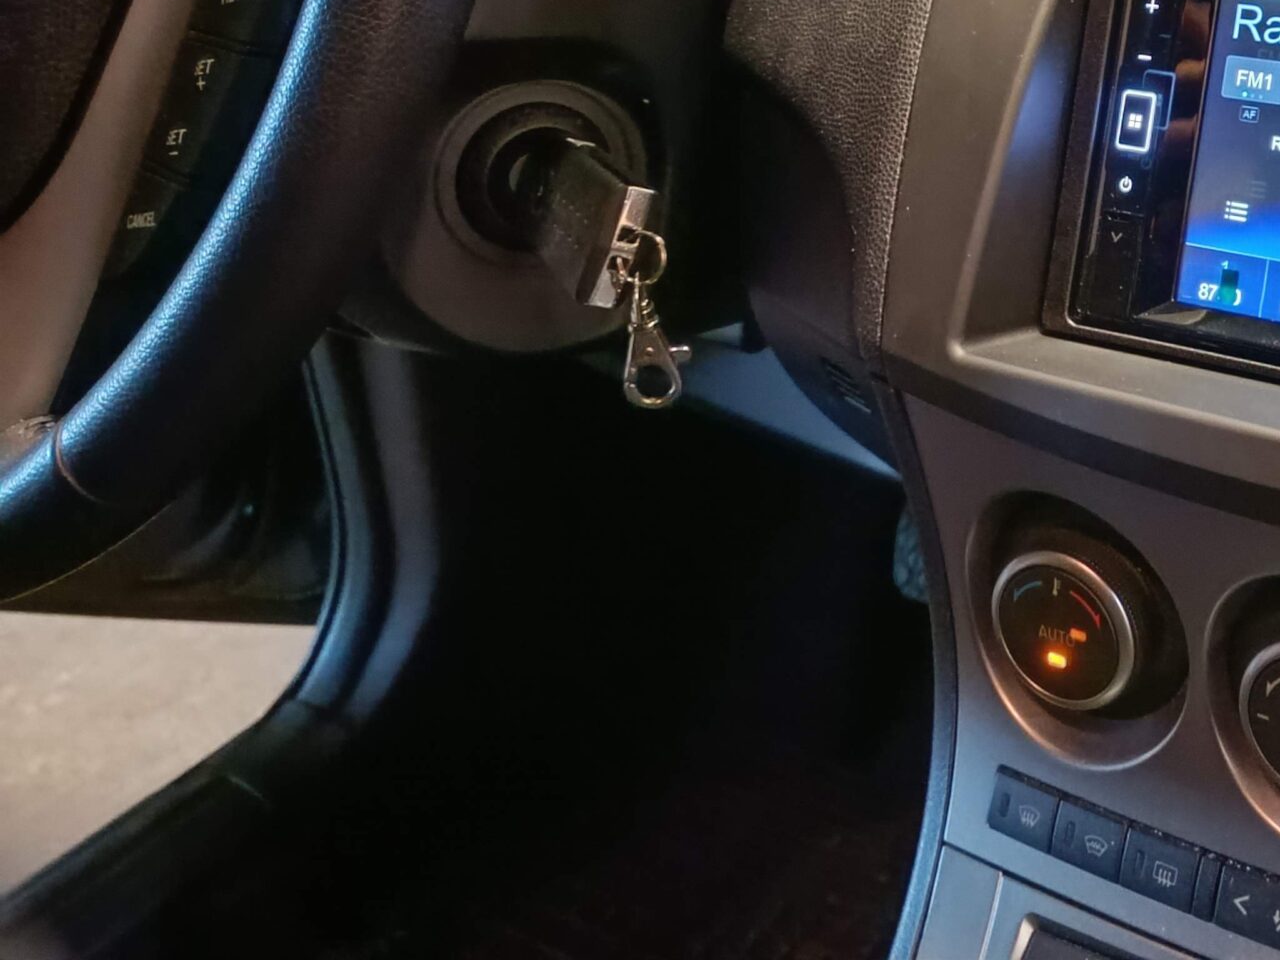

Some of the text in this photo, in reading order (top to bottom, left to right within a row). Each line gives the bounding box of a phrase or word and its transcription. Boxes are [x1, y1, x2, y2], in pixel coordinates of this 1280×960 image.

[1235, 69, 1274, 91] FM1
[1242, 110, 1257, 120] AF
[126, 211, 157, 230] CANCEL
[1038, 624, 1076, 648] AUTO
